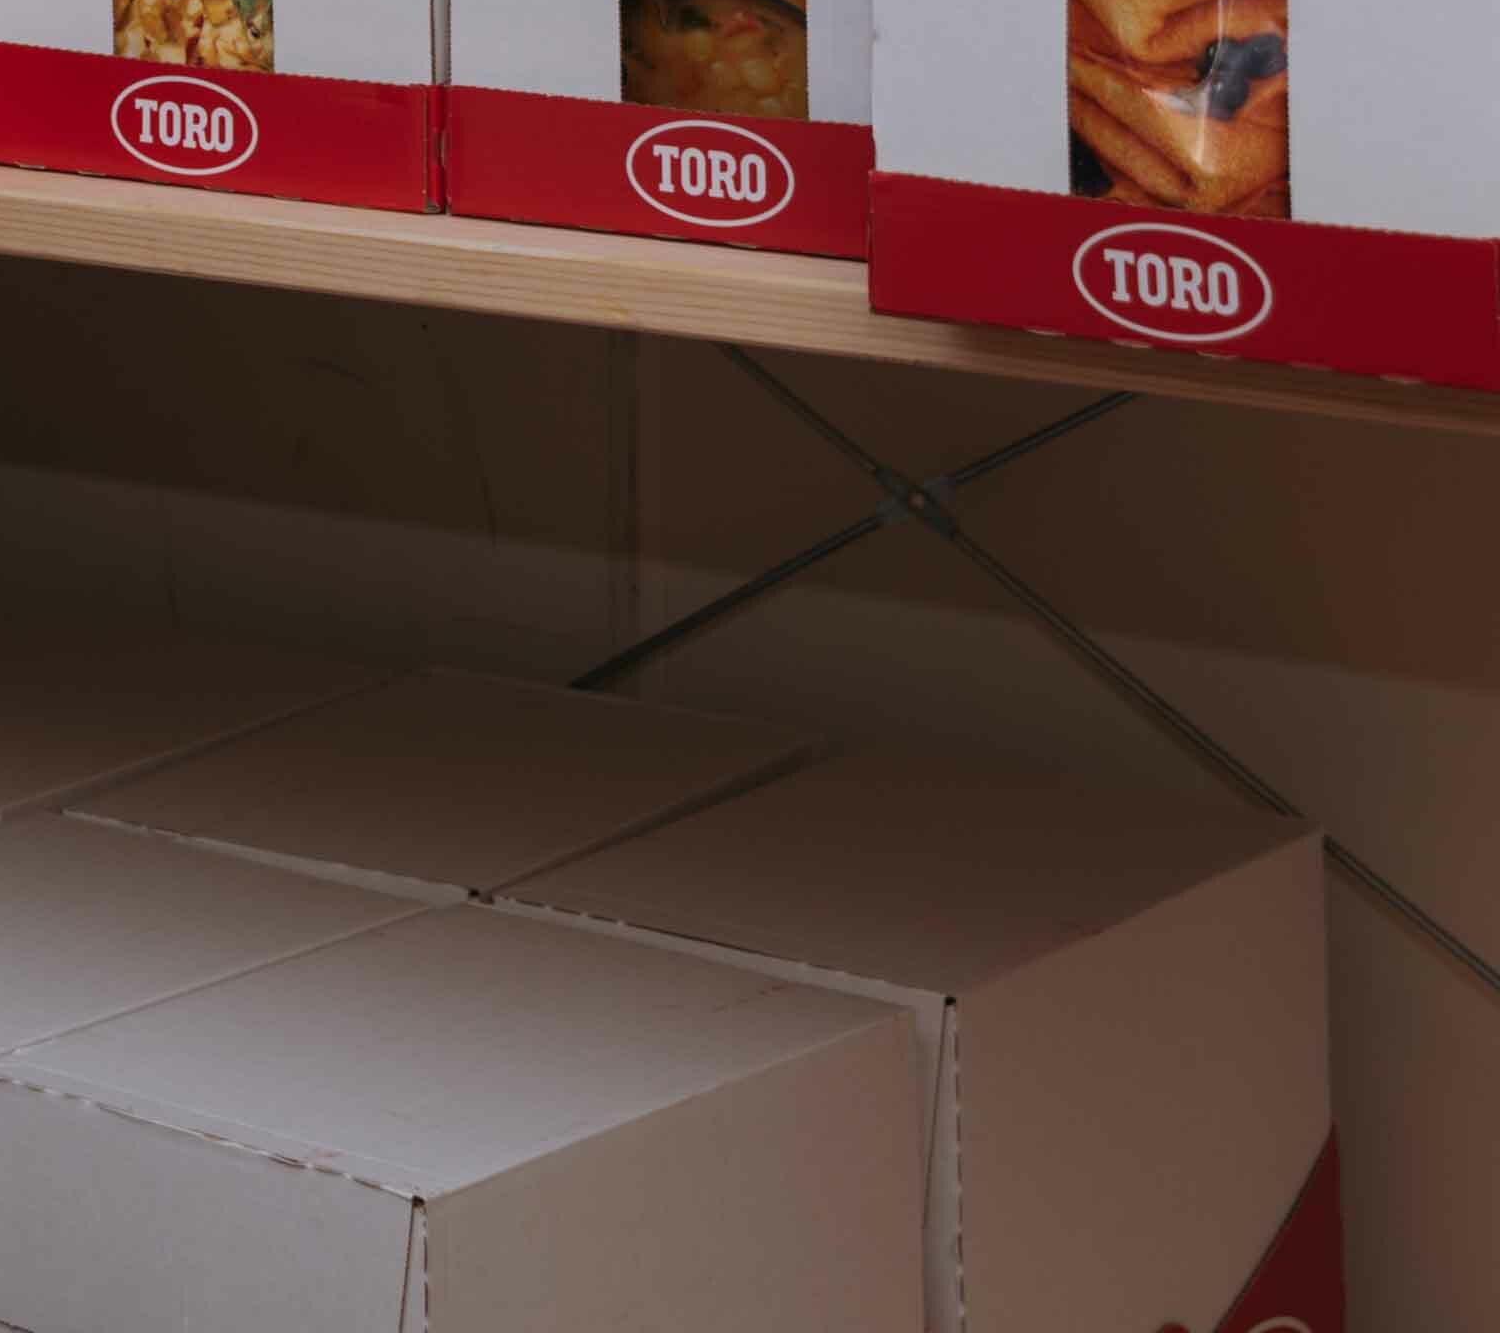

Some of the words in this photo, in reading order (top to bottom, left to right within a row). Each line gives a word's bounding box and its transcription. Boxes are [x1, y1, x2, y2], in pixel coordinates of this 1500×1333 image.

[134, 97, 236, 154] TORO
[652, 143, 768, 203] TORO
[1103, 252, 1241, 316] TORO
